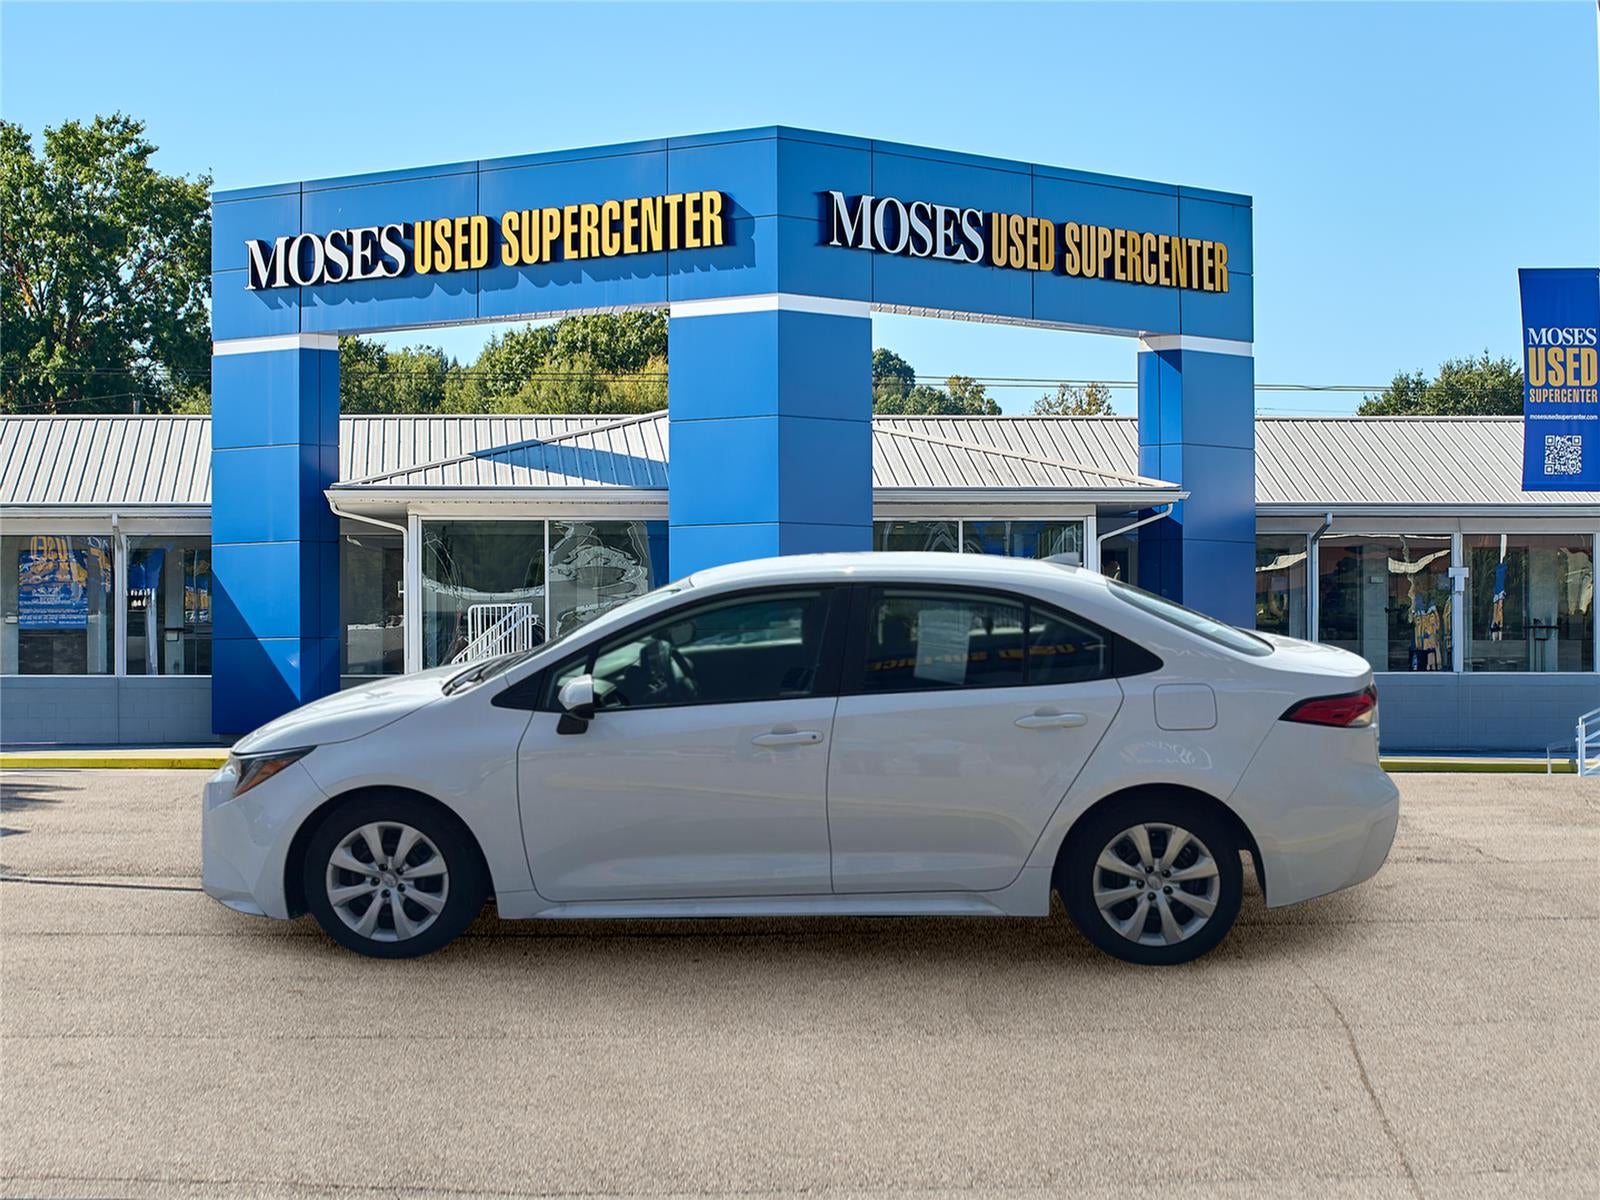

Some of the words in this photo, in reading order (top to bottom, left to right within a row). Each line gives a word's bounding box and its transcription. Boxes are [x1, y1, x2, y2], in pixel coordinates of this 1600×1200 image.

[244, 223, 406, 290] MOSES
[413, 215, 489, 275] USED
[501, 190, 724, 267] SUPERCENTER
[829, 190, 985, 264] MOSES
[991, 211, 1055, 271] USED
[1065, 221, 1229, 293] SUPERCENTER
[1527, 327, 1597, 346] MOSES
[1528, 347, 1598, 387] USED
[1529, 388, 1598, 403] SUPERCENTER
